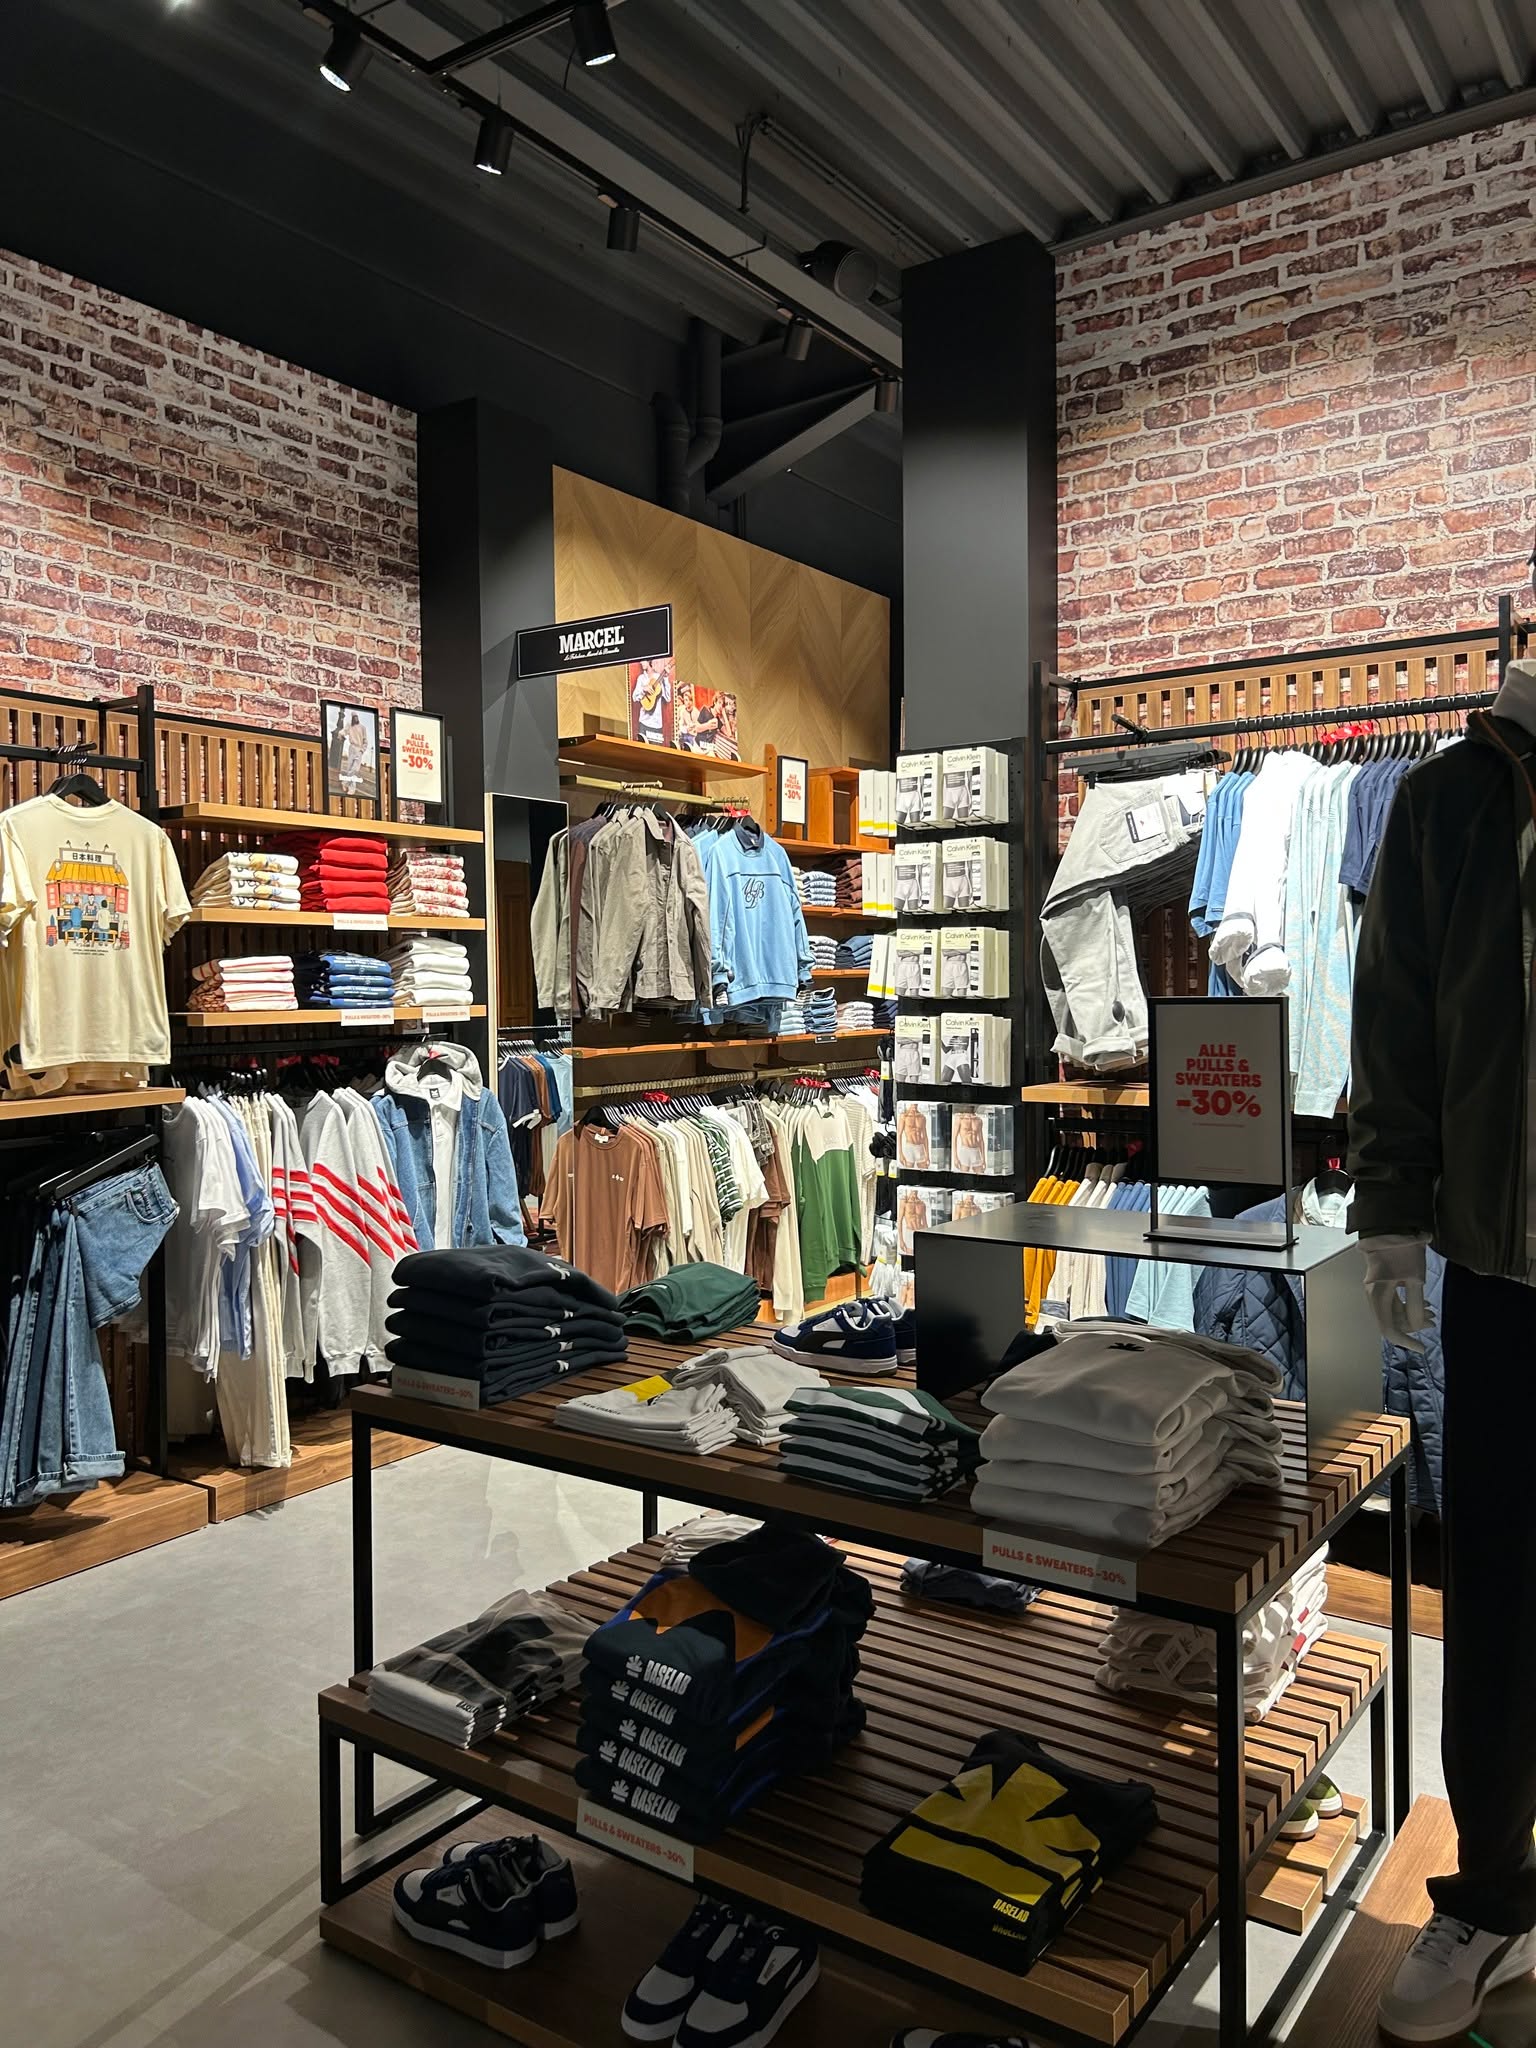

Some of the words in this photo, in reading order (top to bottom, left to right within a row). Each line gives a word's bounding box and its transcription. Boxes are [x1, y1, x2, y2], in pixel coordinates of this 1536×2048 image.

[559, 625, 624, 654] MARCEL
[406, 739, 424, 748] PULLS
[411, 733, 425, 741] ALLE
[402, 746, 433, 756] SWEATERS
[402, 755, 433, 770] -30%
[901, 761, 919, 769] Calvin
[947, 755, 965, 763] Calvin
[72, 853, 102, 862] 日本料理
[899, 1020, 917, 1028] Calvin
[1198, 1044, 1236, 1057] ALLE
[1186, 1058, 1234, 1073] PULLS
[1238, 1059, 1249, 1073] &
[1175, 1072, 1262, 1088] SWEATERS
[1175, 1089, 1262, 1118] -30%
[992, 1544, 1024, 1562] PULLS
[1025, 1553, 1033, 1564] &
[1035, 1554, 1094, 1578] SWEATERS
[1095, 1569, 1127, 1585] -30%
[643, 1660, 693, 1696] BASELAB
[629, 1687, 678, 1726] BASELAB
[638, 1726, 688, 1768] BASELAB
[617, 1748, 665, 1787] BASELAB
[631, 1786, 681, 1824] BASELAB
[583, 1813, 609, 1832] PULLS
[609, 1824, 616, 1836] &
[616, 1828, 662, 1856] SWEATERS
[662, 1850, 686, 1867] -30%
